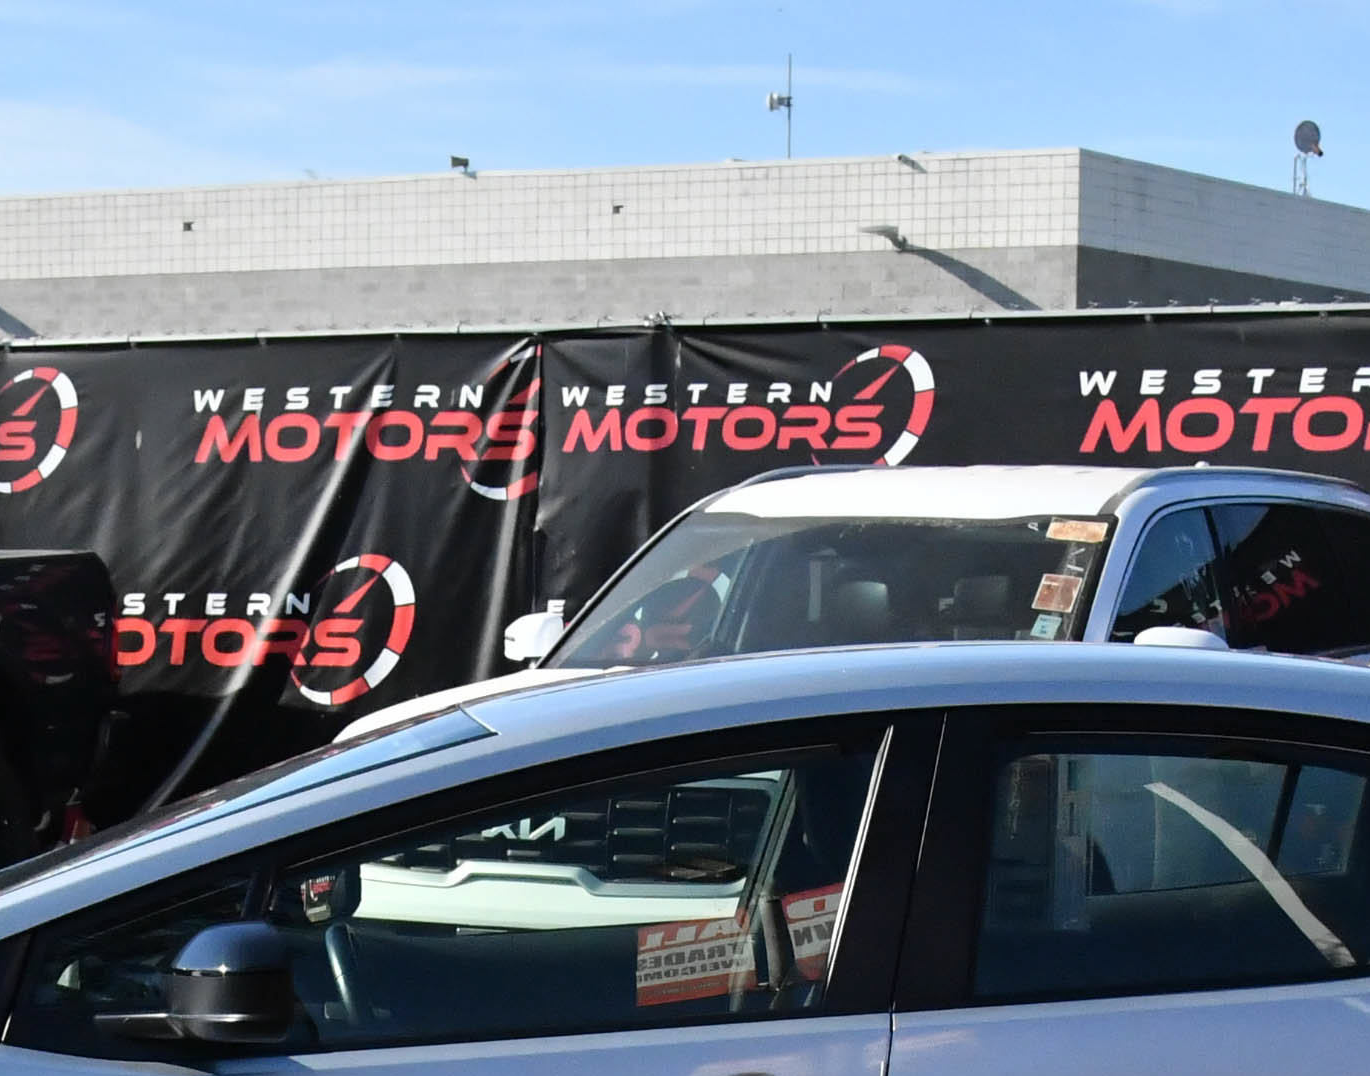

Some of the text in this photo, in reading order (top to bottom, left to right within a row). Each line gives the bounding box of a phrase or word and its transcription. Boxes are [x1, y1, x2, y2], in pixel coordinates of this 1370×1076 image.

[193, 383, 484, 413] WESTERN
[561, 381, 833, 408] WESTERN
[195, 409, 539, 463] MOTORS
[563, 404, 884, 453] MOTORS
